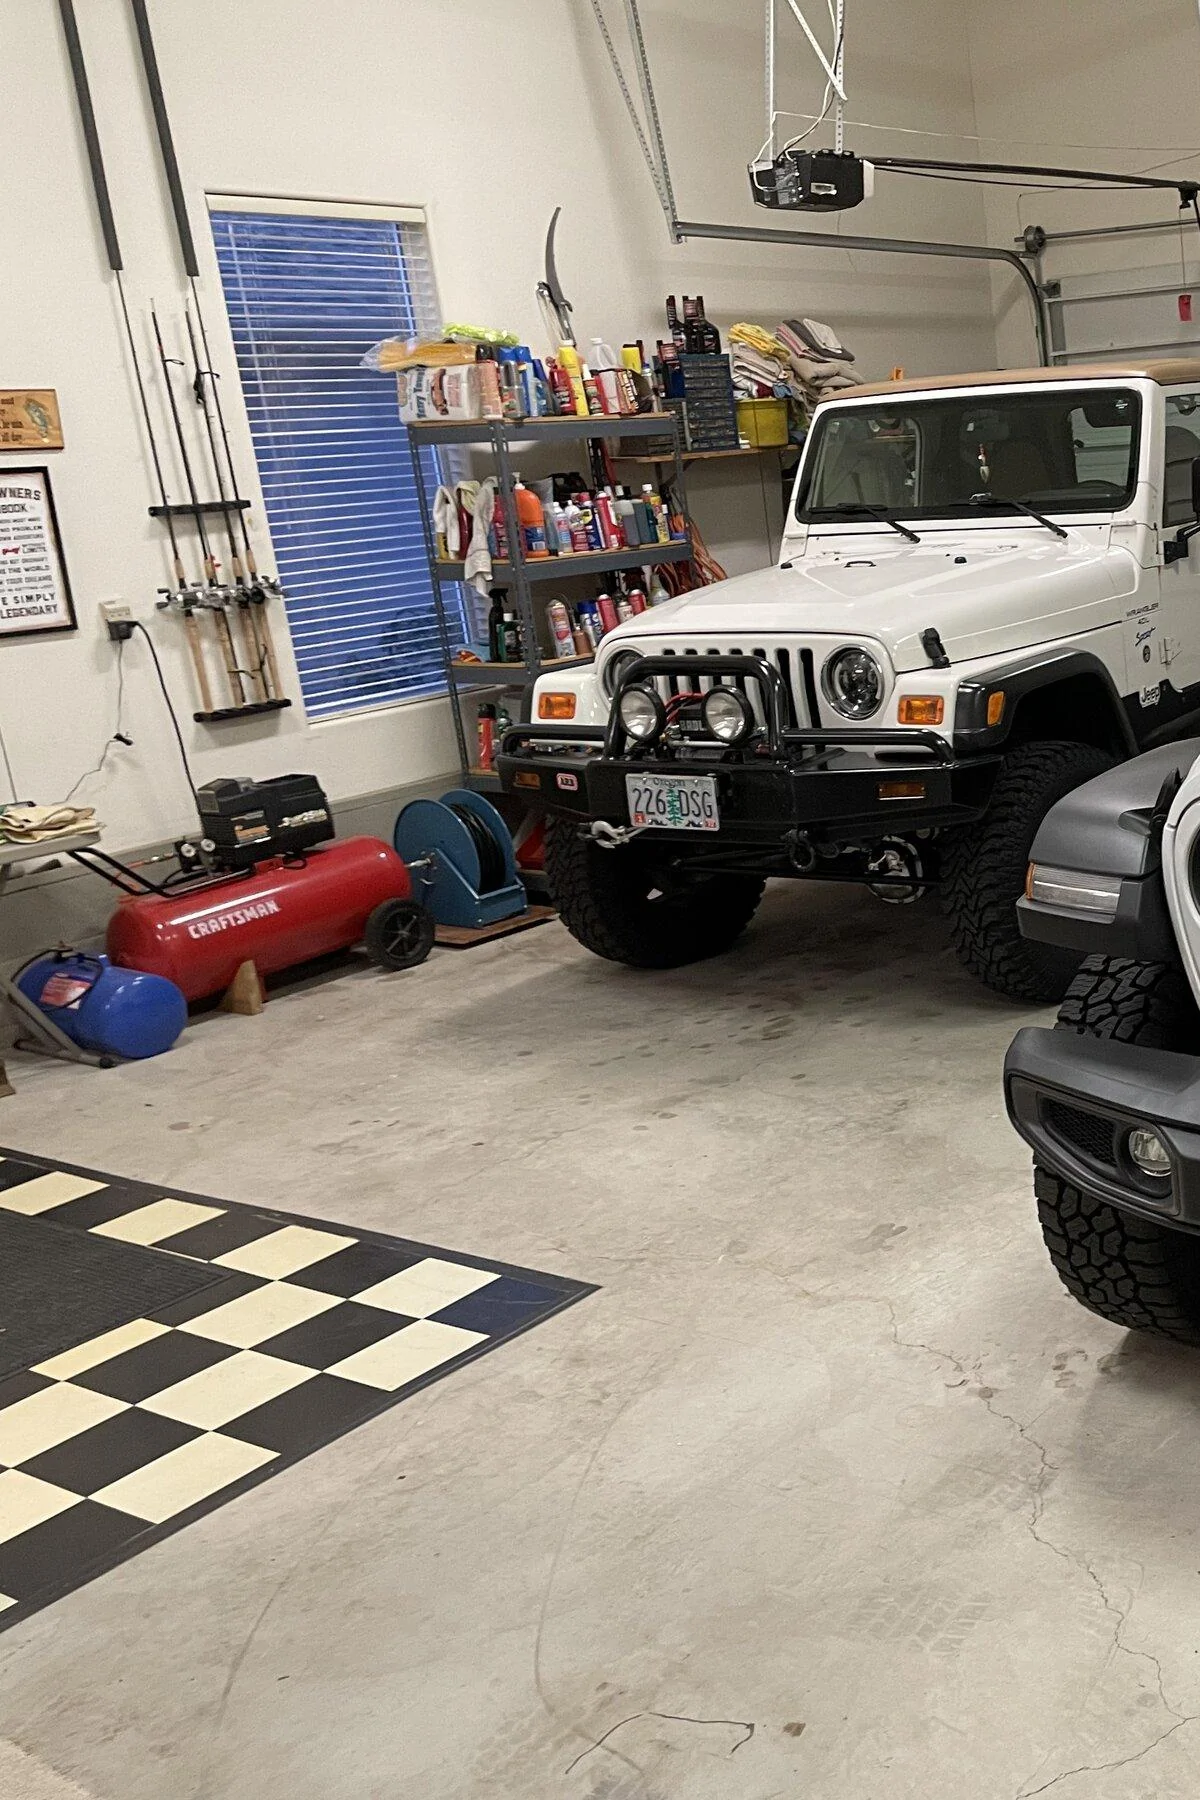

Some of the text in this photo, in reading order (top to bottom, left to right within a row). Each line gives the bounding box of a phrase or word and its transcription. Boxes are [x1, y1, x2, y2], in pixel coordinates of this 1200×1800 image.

[13, 592, 55, 604] SIMPLY
[0, 604, 57, 619] LEGENDARY
[1126, 602, 1159, 617] WRANGLER
[1141, 686, 1160, 703] Jeep
[653, 777, 686, 788] Oregon
[633, 787, 713, 818] 226 DSG
[188, 900, 281, 939] CRAFTSMAN
